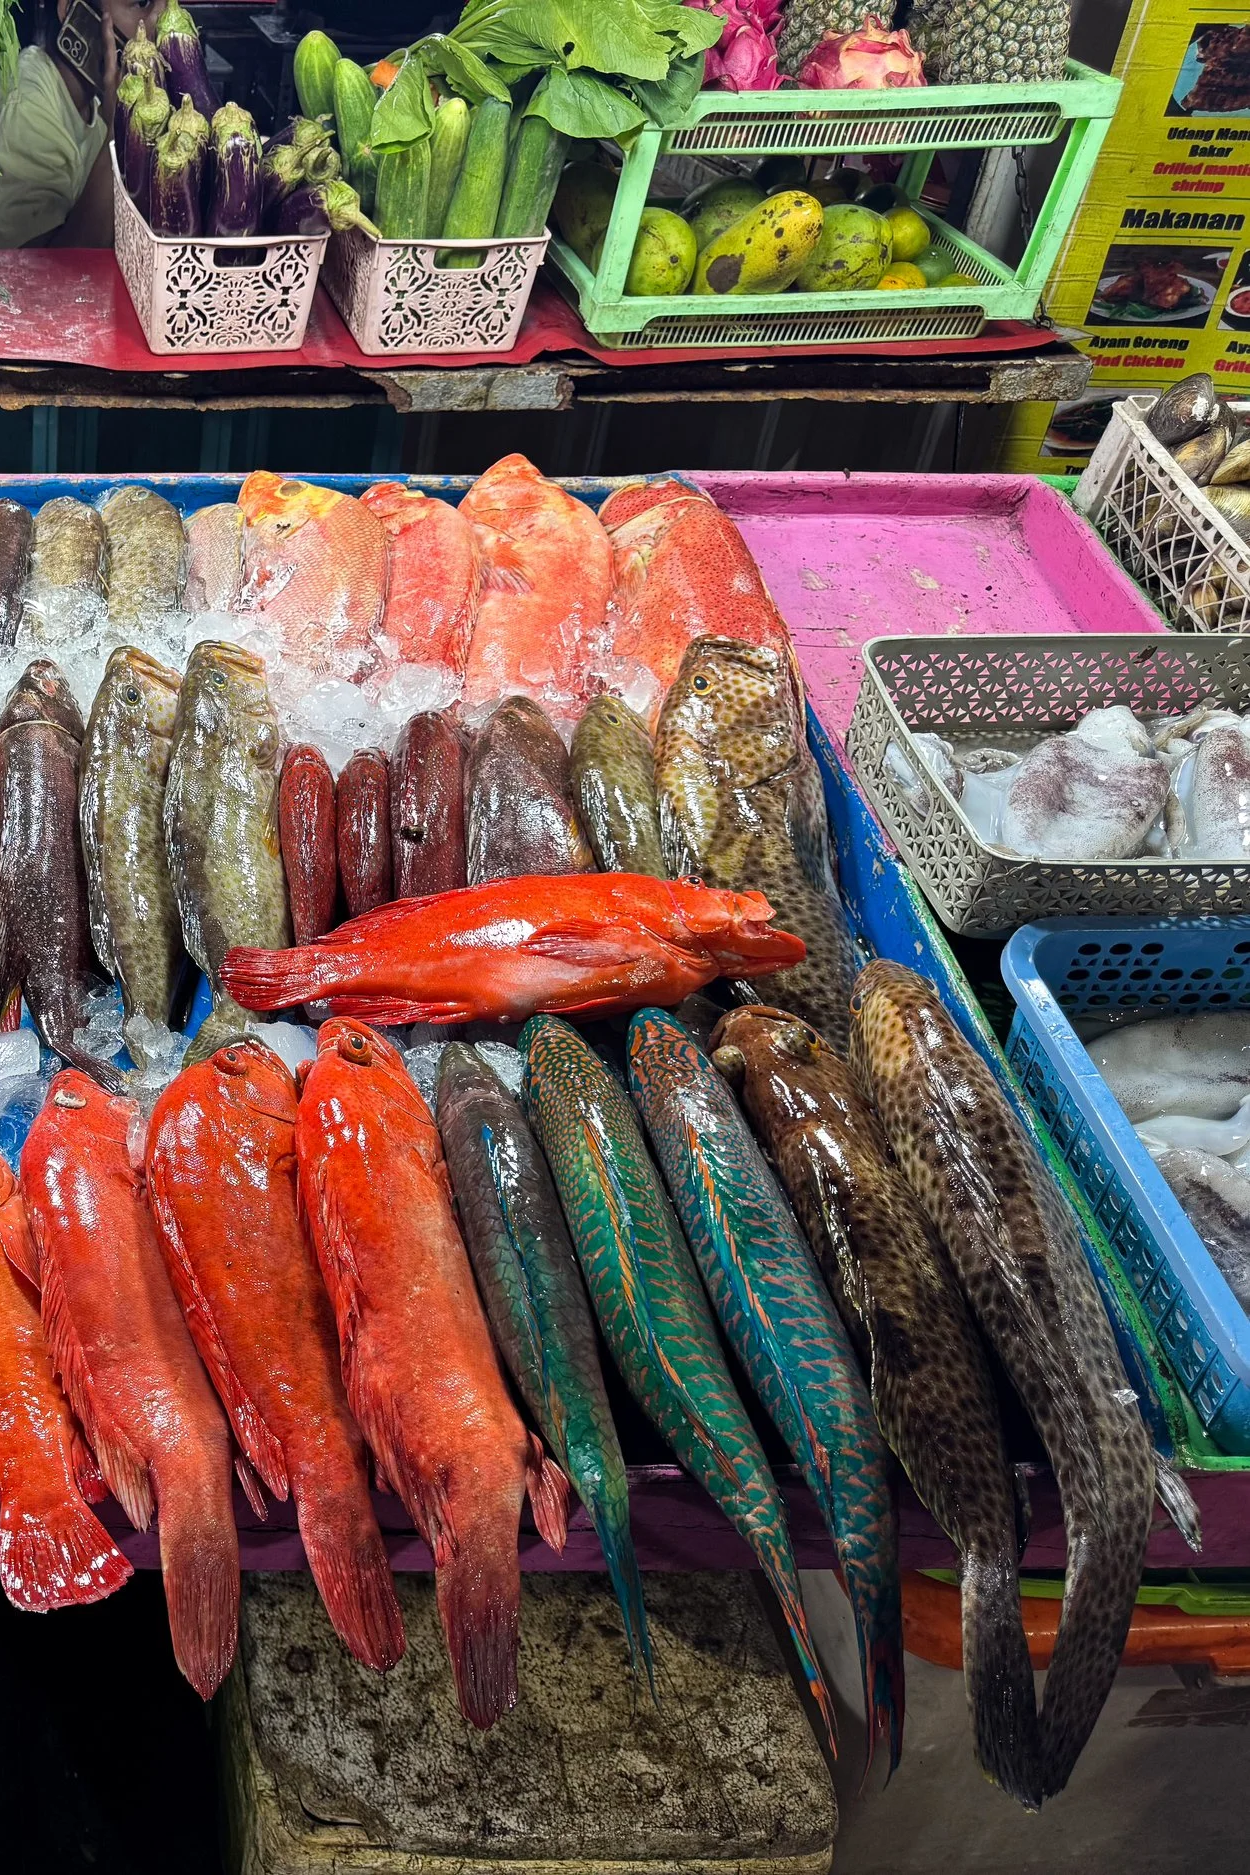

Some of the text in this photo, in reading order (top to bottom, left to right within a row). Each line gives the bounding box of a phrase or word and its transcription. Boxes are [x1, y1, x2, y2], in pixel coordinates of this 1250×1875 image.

[1167, 127, 1215, 141] Udang
[1188, 145, 1233, 157] Bakar
[1153, 162, 1203, 174] Grilled
[1171, 180, 1225, 193] shrimp
[1120, 208, 1245, 230] Makanan
[1089, 336, 1190, 351] Ayam Goreng
[1087, 354, 1186, 368] ried Chicken
